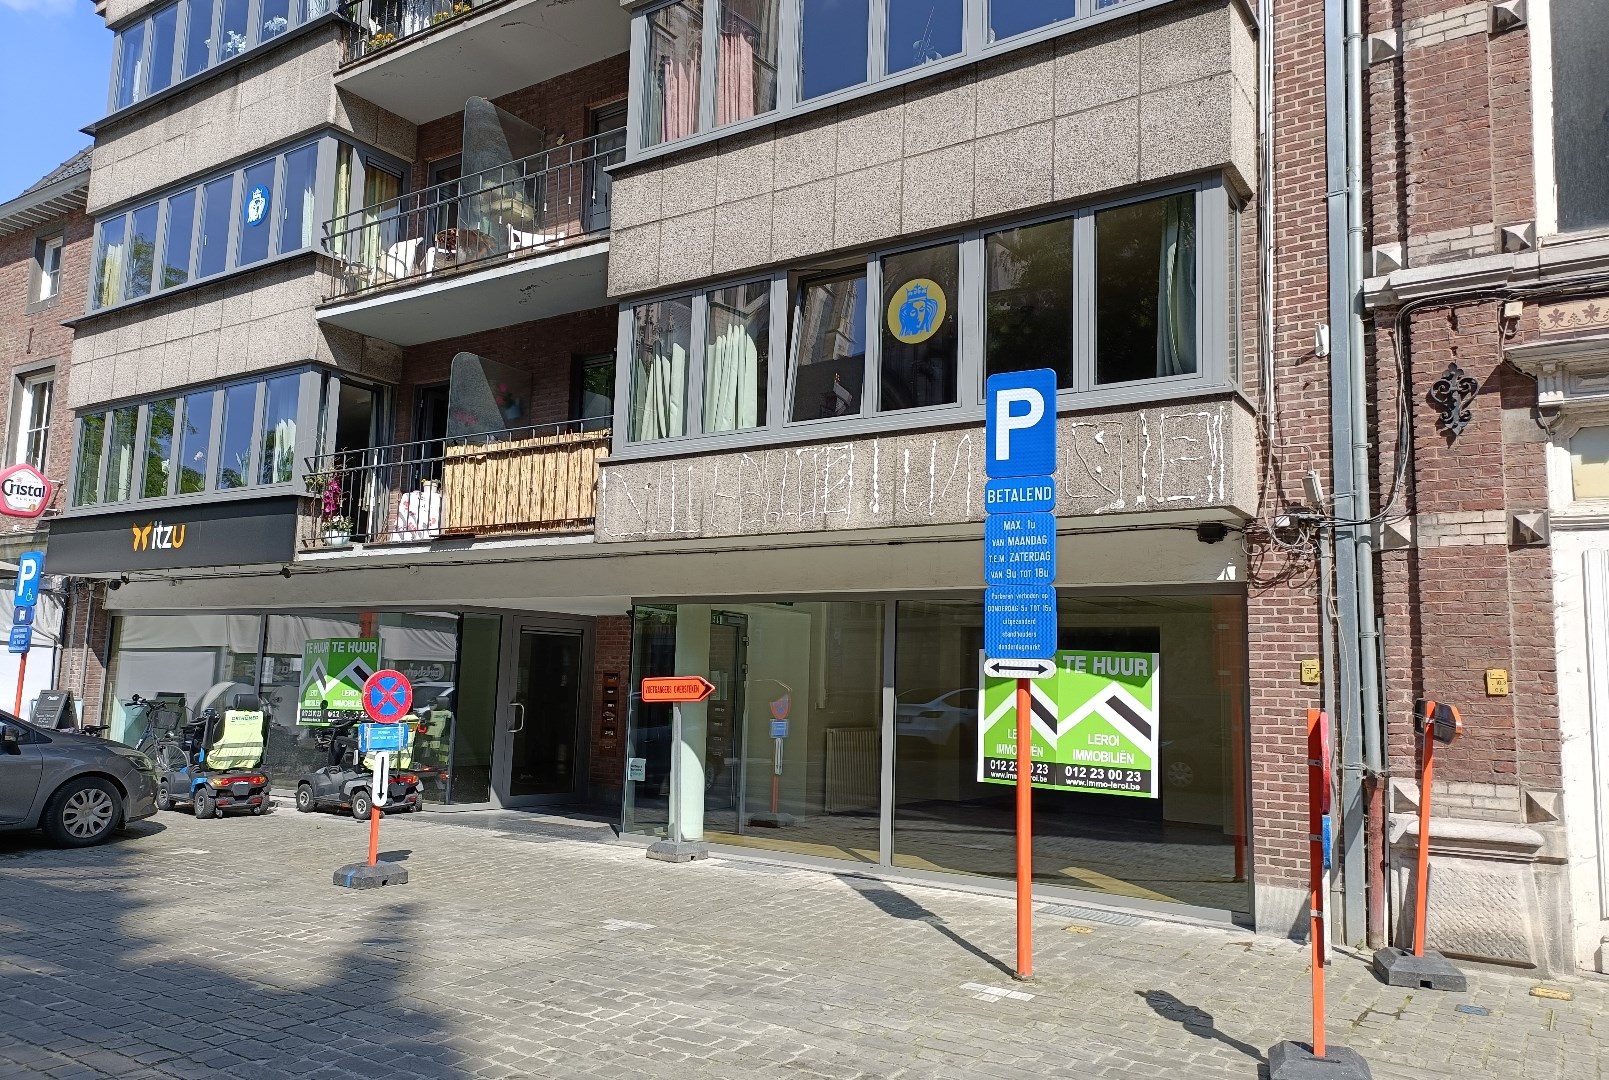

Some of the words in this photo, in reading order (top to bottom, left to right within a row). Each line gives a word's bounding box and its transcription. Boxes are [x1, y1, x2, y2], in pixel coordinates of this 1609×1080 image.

[996, 388, 1044, 460] P
[2, 479, 46, 498] Cristal
[988, 486, 1052, 504] BETALEND
[1004, 520, 1022, 530] MAX.
[1028, 520, 1036, 529] 1u
[1008, 535, 1047, 546] MAANDAG
[989, 555, 1006, 563] T.E.M.
[1010, 551, 1051, 562] ZATERDAG
[18, 559, 36, 596] P
[1007, 569, 1016, 578] 9u
[1020, 570, 1032, 578] TOT
[1036, 568, 1049, 577] 18u
[1002, 618, 1036, 626] uitgezonderd
[332, 642, 345, 652] TE
[348, 642, 376, 653] HUUR
[1063, 656, 1087, 674] TE
[1092, 657, 1148, 676] HUUR
[1088, 734, 1120, 746] LEROI
[1072, 749, 1135, 765] IMMOBILIËN
[990, 760, 1006, 770] 012
[1037, 764, 1048, 774] 23
[1065, 766, 1087, 778] 012
[1090, 768, 1104, 779] 23
[1108, 770, 1122, 780] 00
[1126, 771, 1141, 782] 23
[1066, 779, 1140, 790] www.immo-leroi.be
